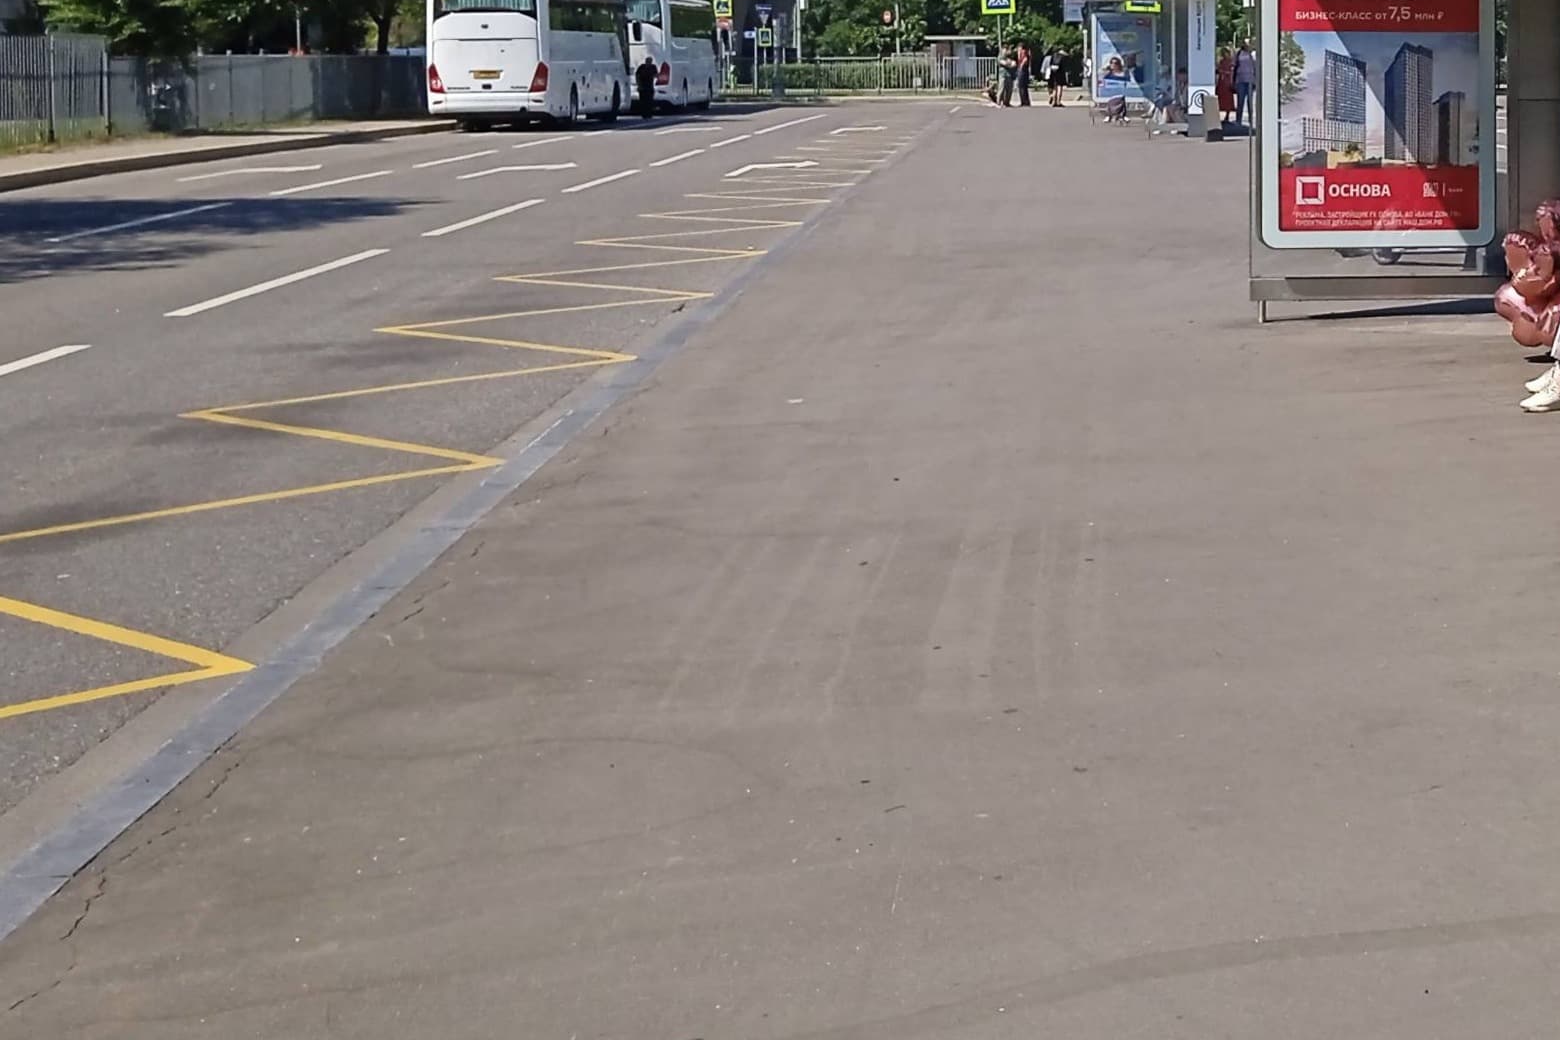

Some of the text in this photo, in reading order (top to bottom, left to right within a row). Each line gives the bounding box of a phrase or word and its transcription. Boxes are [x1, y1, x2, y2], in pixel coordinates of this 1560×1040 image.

[1295, 11, 1372, 20] БИЗНЕС-КЛАСС
[1388, 6, 1411, 22] 7,5
[1328, 184, 1391, 197] ОСНОВА
